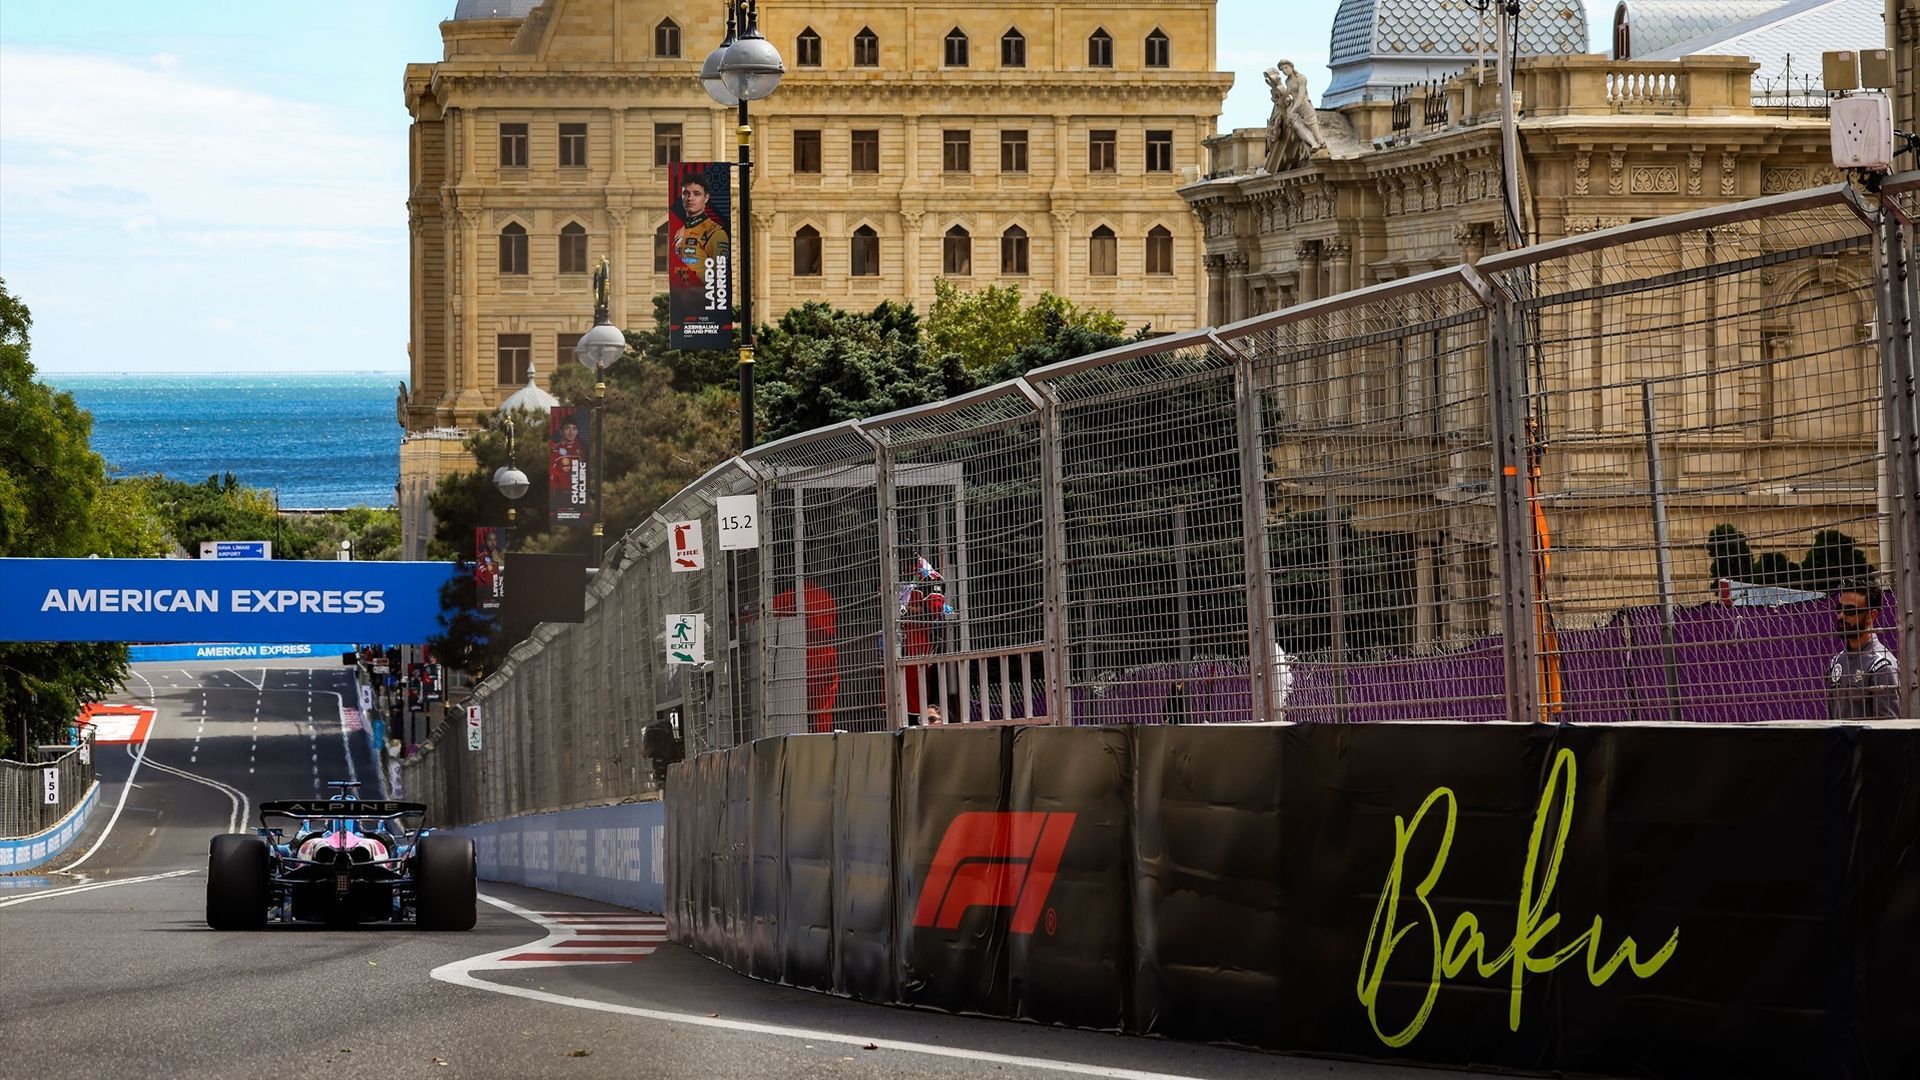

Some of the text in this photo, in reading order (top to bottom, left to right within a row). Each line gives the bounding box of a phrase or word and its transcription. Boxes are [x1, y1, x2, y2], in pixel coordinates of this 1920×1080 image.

[704, 257, 715, 310] LANDO
[716, 255, 727, 310] NORRIS
[571, 459, 579, 504] CHARLES
[579, 462, 587, 504] LECLERC
[721, 515, 753, 531] 15.2
[677, 549, 699, 557] FIRE
[40, 589, 386, 613] AMERICAN EXPRESS
[196, 644, 312, 657] AMERICAN EXPRESS
[289, 803, 399, 811] ALPINE
[912, 811, 1078, 935] F1
[1357, 747, 1680, 1049] Baku
